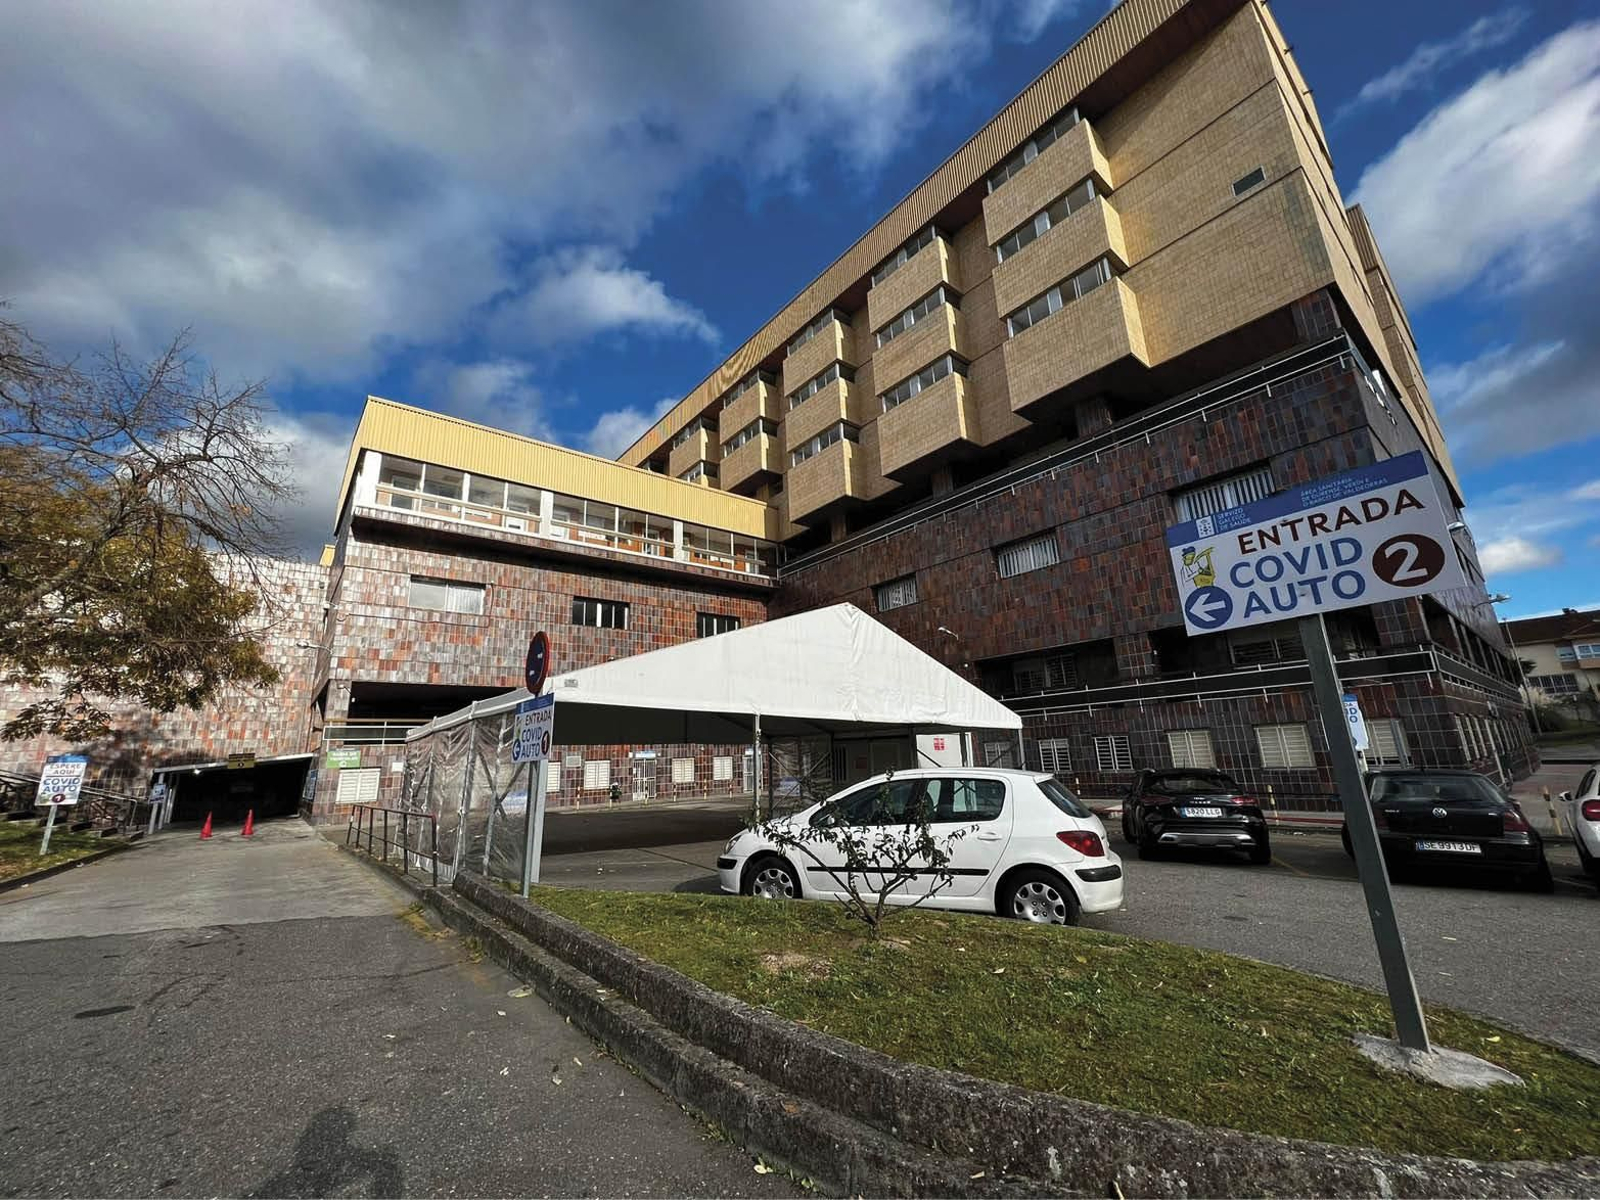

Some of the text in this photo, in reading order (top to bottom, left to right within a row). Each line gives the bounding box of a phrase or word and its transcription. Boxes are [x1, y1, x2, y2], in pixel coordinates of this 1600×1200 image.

[1218, 507, 1243, 519] SERVIZO
[1218, 513, 1245, 524] GALEGO
[1237, 488, 1425, 555] ENTRADA
[1229, 537, 1364, 589] COVID
[1384, 541, 1428, 582] 2
[1243, 569, 1366, 619] AUTO
[525, 710, 551, 726] ENTRADA
[522, 727, 542, 742] COVID
[520, 743, 540, 758] AUTO
[43, 778, 80, 786] COVID
[43, 784, 77, 792] AUTO
